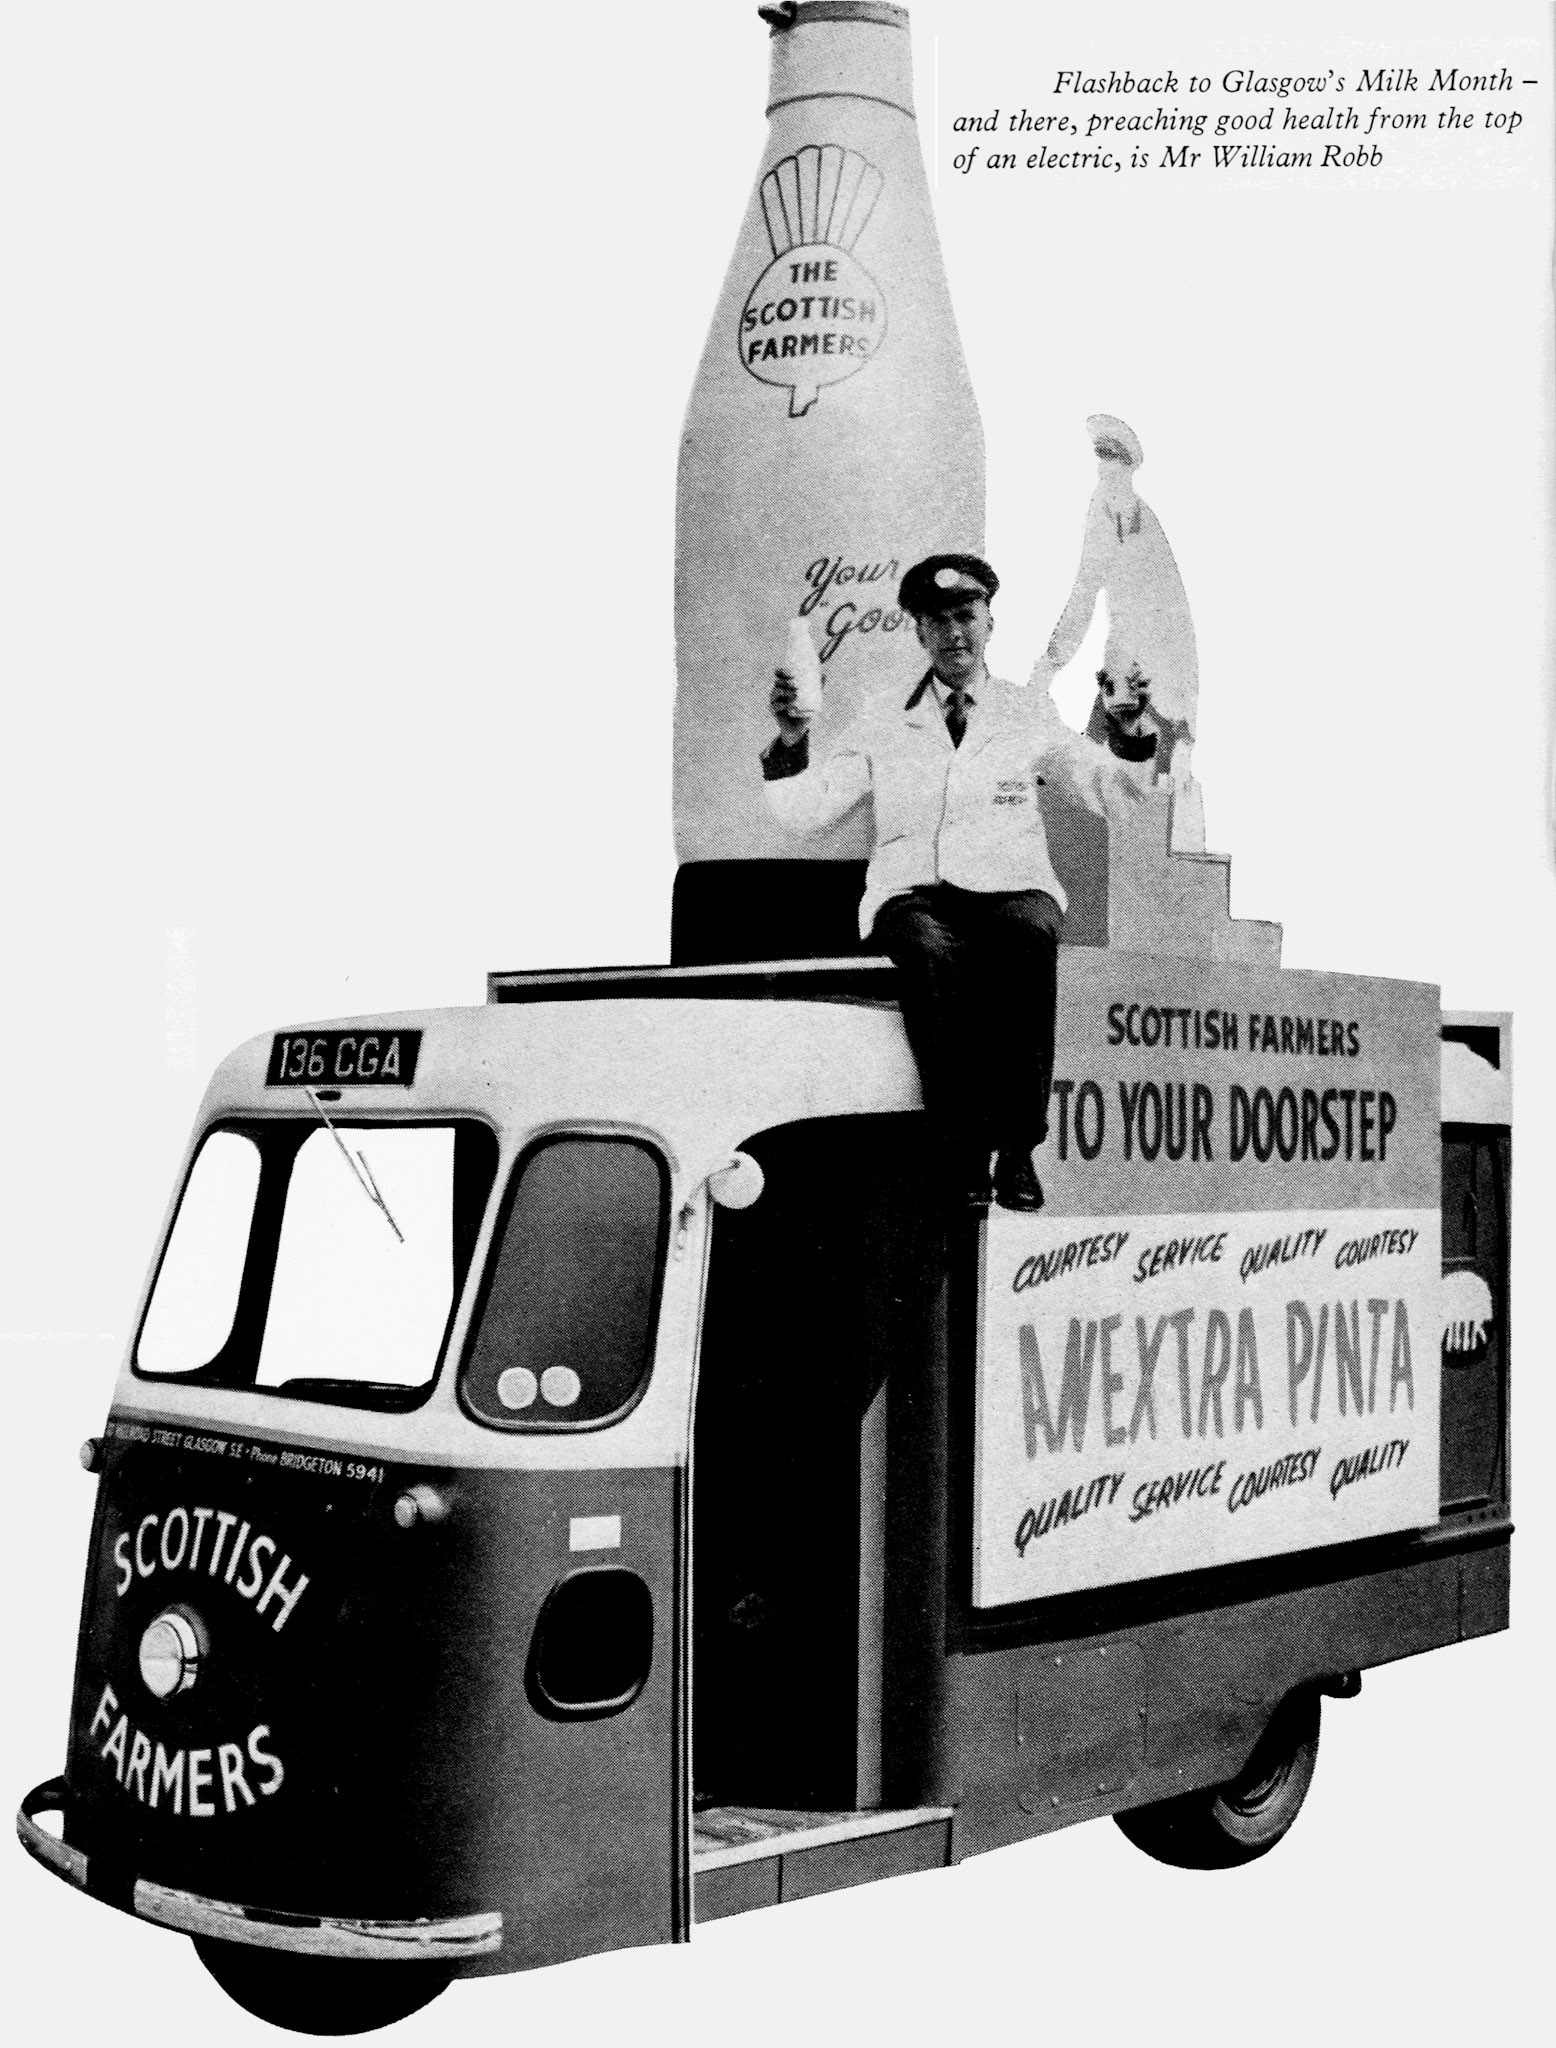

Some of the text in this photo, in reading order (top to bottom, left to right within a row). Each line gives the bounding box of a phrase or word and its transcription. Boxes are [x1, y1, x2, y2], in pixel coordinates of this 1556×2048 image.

[789, 259, 838, 284] THE
[744, 296, 876, 333] SCOTTISH
[748, 332, 872, 365] FARMERS
[798, 555, 900, 617] Your
[280, 1037, 400, 1079] 136 CGA
[1107, 1002, 1361, 1057] SCOTTISH FARMERS
[1053, 1079, 1397, 1163] TO YOUR DOORSTEP
[1012, 1228, 1419, 1295] COURTESY SERVICE QUALITY COURTESY
[1285, 1298, 1415, 1428] PINTA
[183, 1434, 228, 1455] GLASGOW
[280, 1450, 342, 1476] BRIDGETON
[346, 1462, 384, 1483] 5941
[1014, 1438, 1411, 1558] QUALITY SERVICE COURTESY QUALITY
[114, 1507, 310, 1632] SCOTTISH
[90, 1682, 284, 1817] FARMERS
